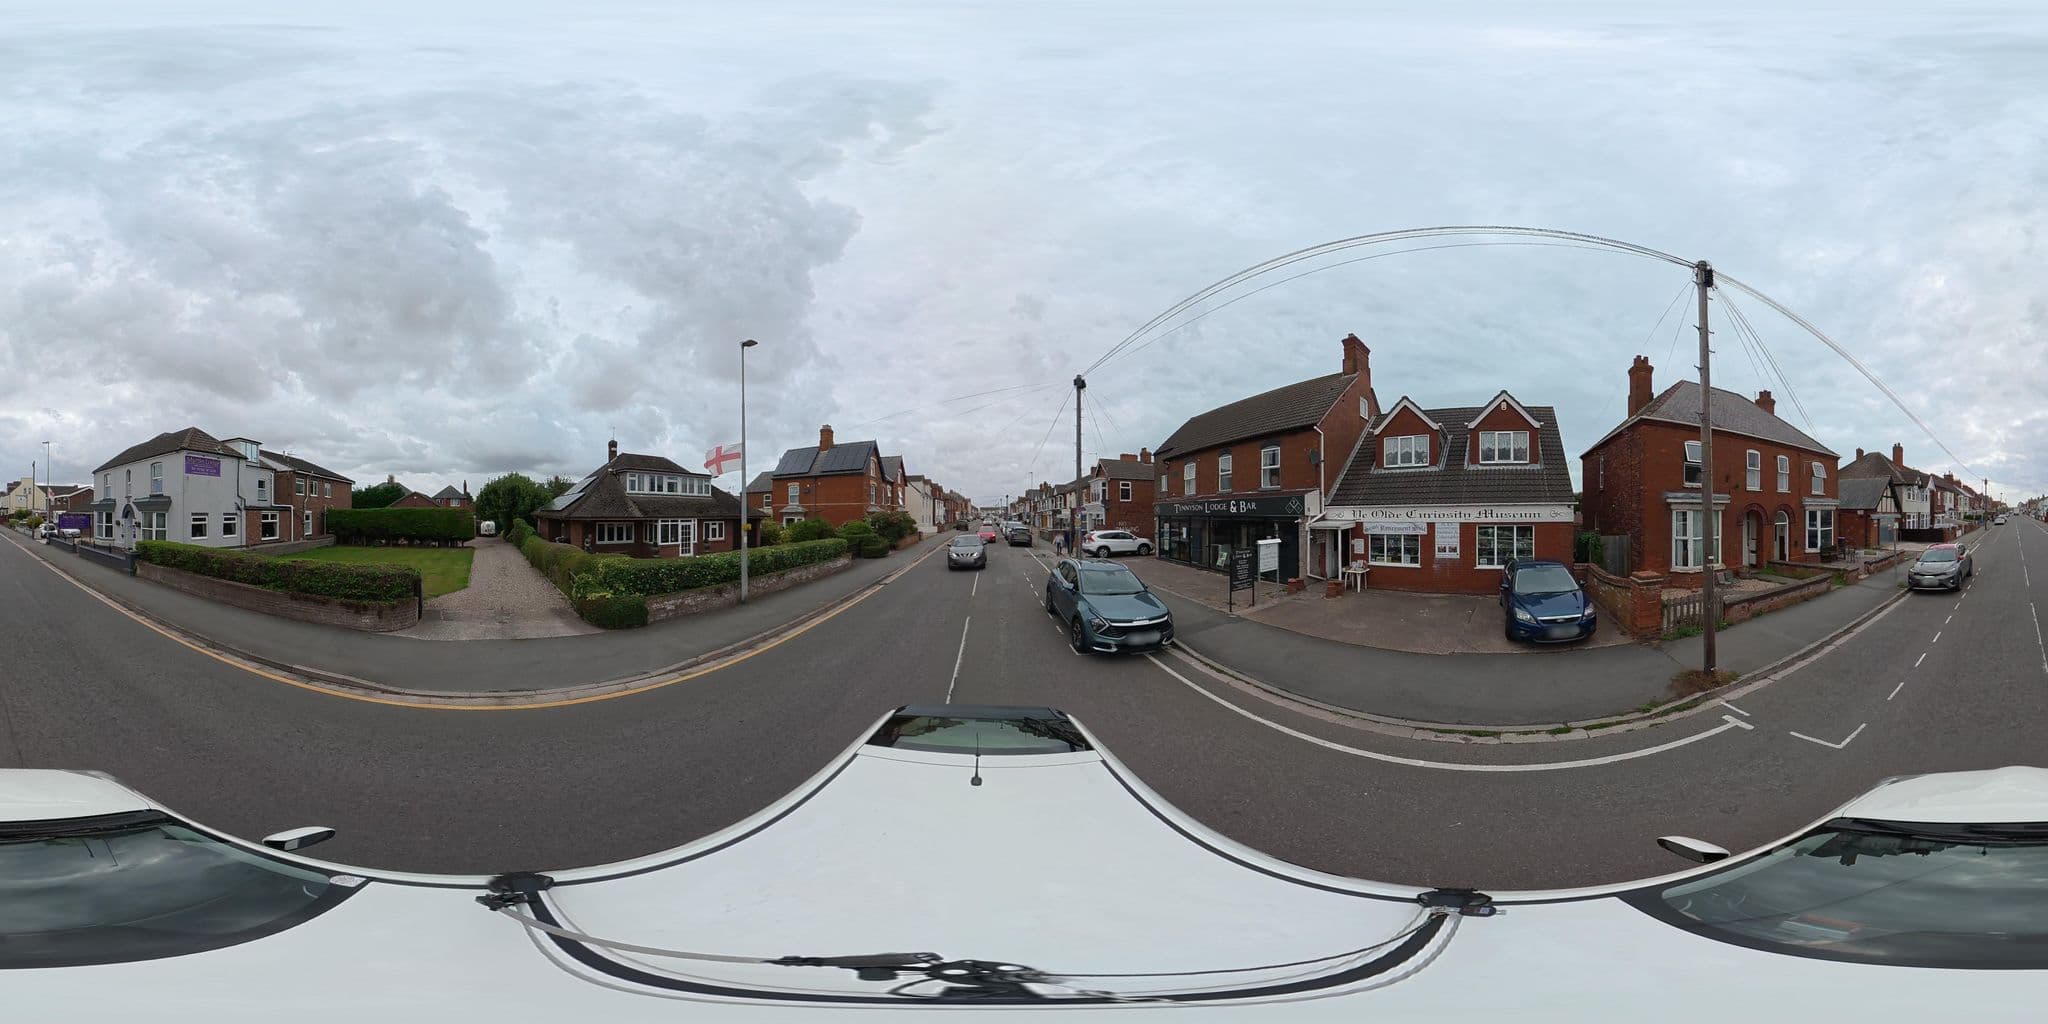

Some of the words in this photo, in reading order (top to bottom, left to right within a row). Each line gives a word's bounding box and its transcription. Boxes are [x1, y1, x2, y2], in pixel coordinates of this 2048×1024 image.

[1204, 502, 1228, 514] LODGE
[1229, 500, 1237, 513] &
[1239, 500, 1257, 513] BAR
[1371, 509, 1402, 519] Olde
[1405, 509, 1471, 520] Curiosity
[1474, 508, 1541, 519] Museum
